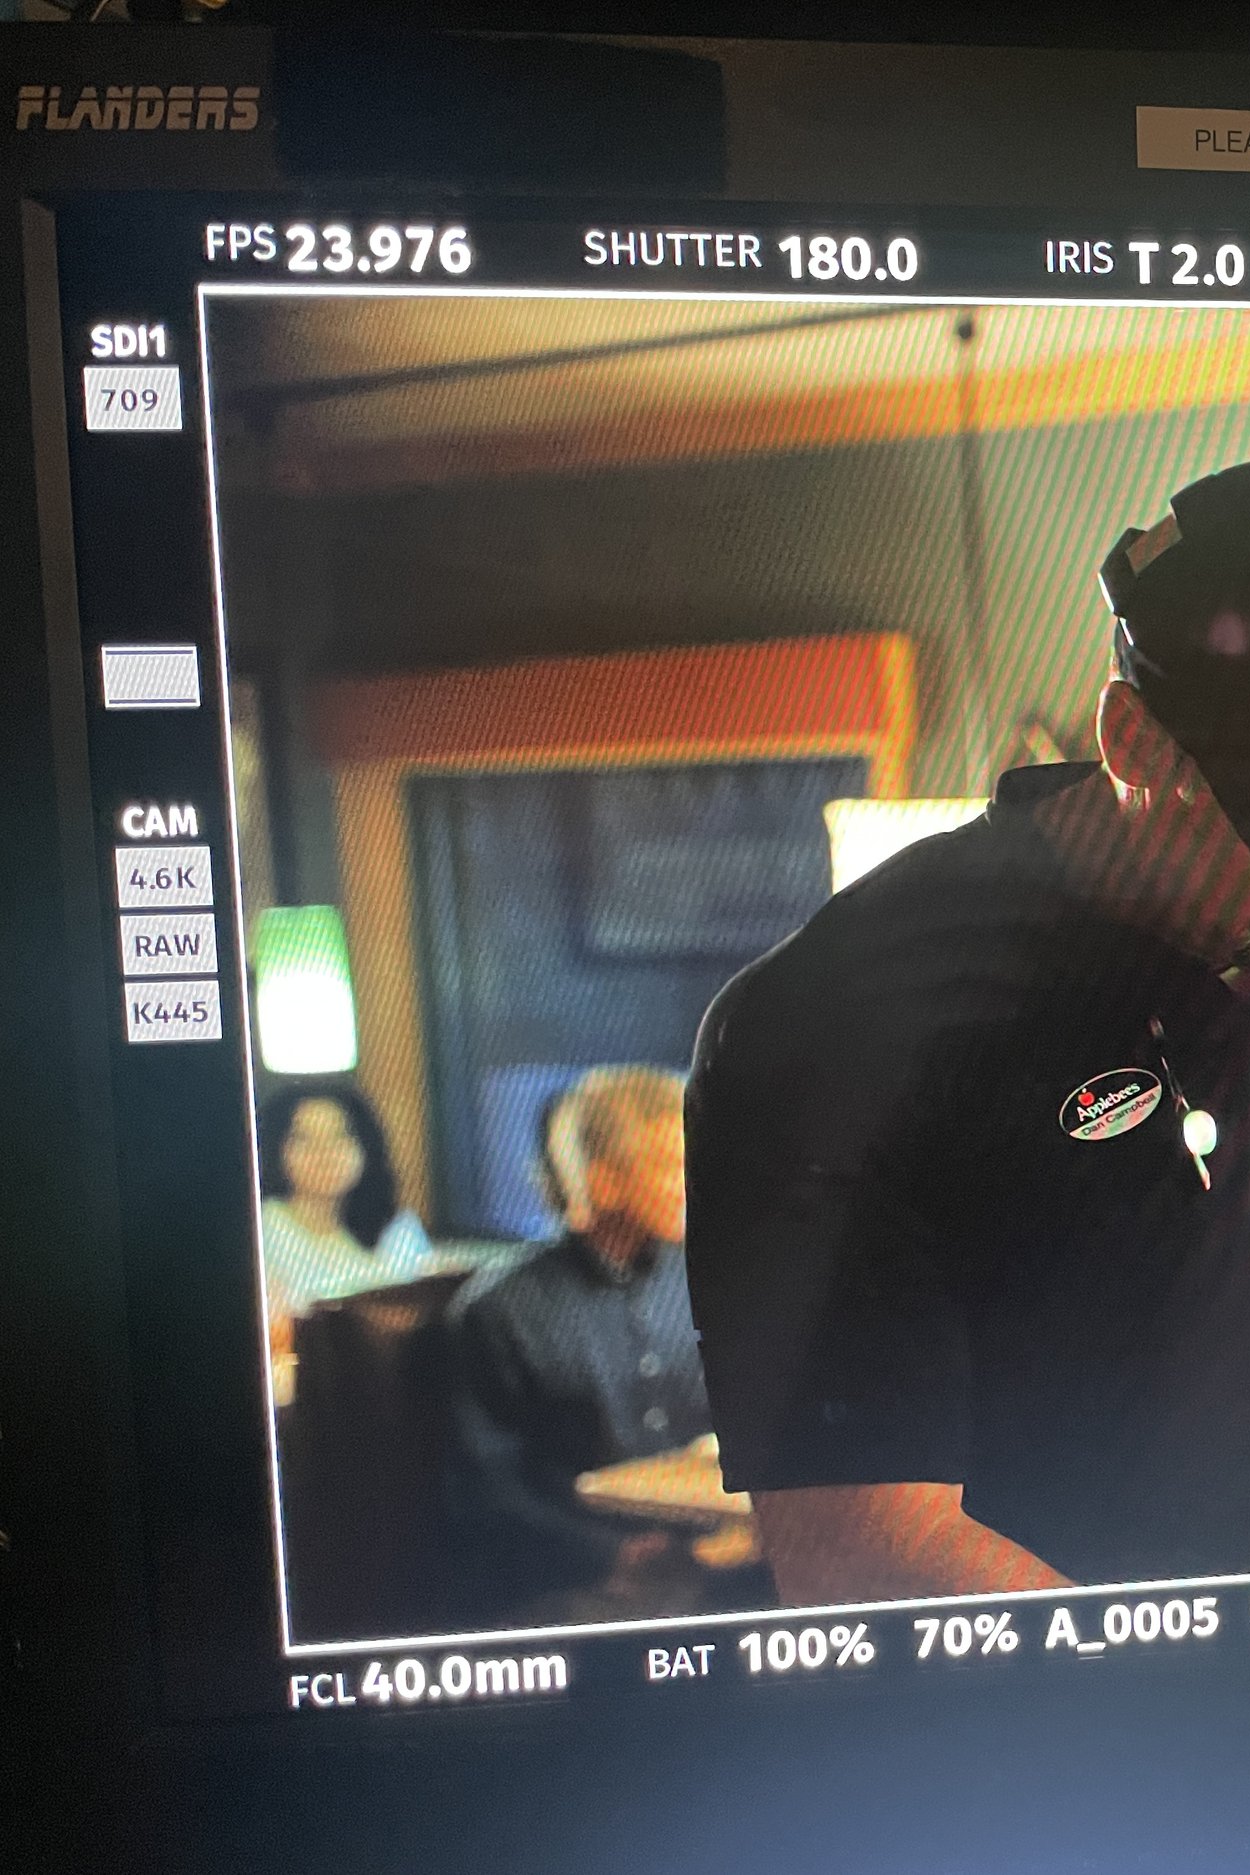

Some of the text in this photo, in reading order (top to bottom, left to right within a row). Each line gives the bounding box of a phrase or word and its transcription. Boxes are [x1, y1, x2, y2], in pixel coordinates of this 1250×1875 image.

[17, 87, 259, 130] FLANDERS
[206, 223, 276, 260] FPS
[285, 223, 472, 275] 23.976
[585, 229, 762, 267] SHUTTER
[779, 235, 918, 281] 180.0
[1047, 241, 1113, 273] IRIS
[1129, 241, 1160, 284] T
[1171, 243, 1245, 286] 2.0
[91, 324, 166, 358] SDI1
[100, 388, 159, 413] 709
[121, 804, 198, 839] CAM
[130, 867, 196, 890] 4.6K
[135, 934, 200, 957] RAW
[133, 1001, 208, 1024] K445
[290, 1673, 356, 1708] FCL
[362, 1654, 567, 1702] 40.0mm
[648, 1645, 715, 1680] BAT
[738, 1623, 876, 1673] 100%
[913, 1612, 1019, 1658] 70%
[1044, 1598, 1220, 1653] A_0005
